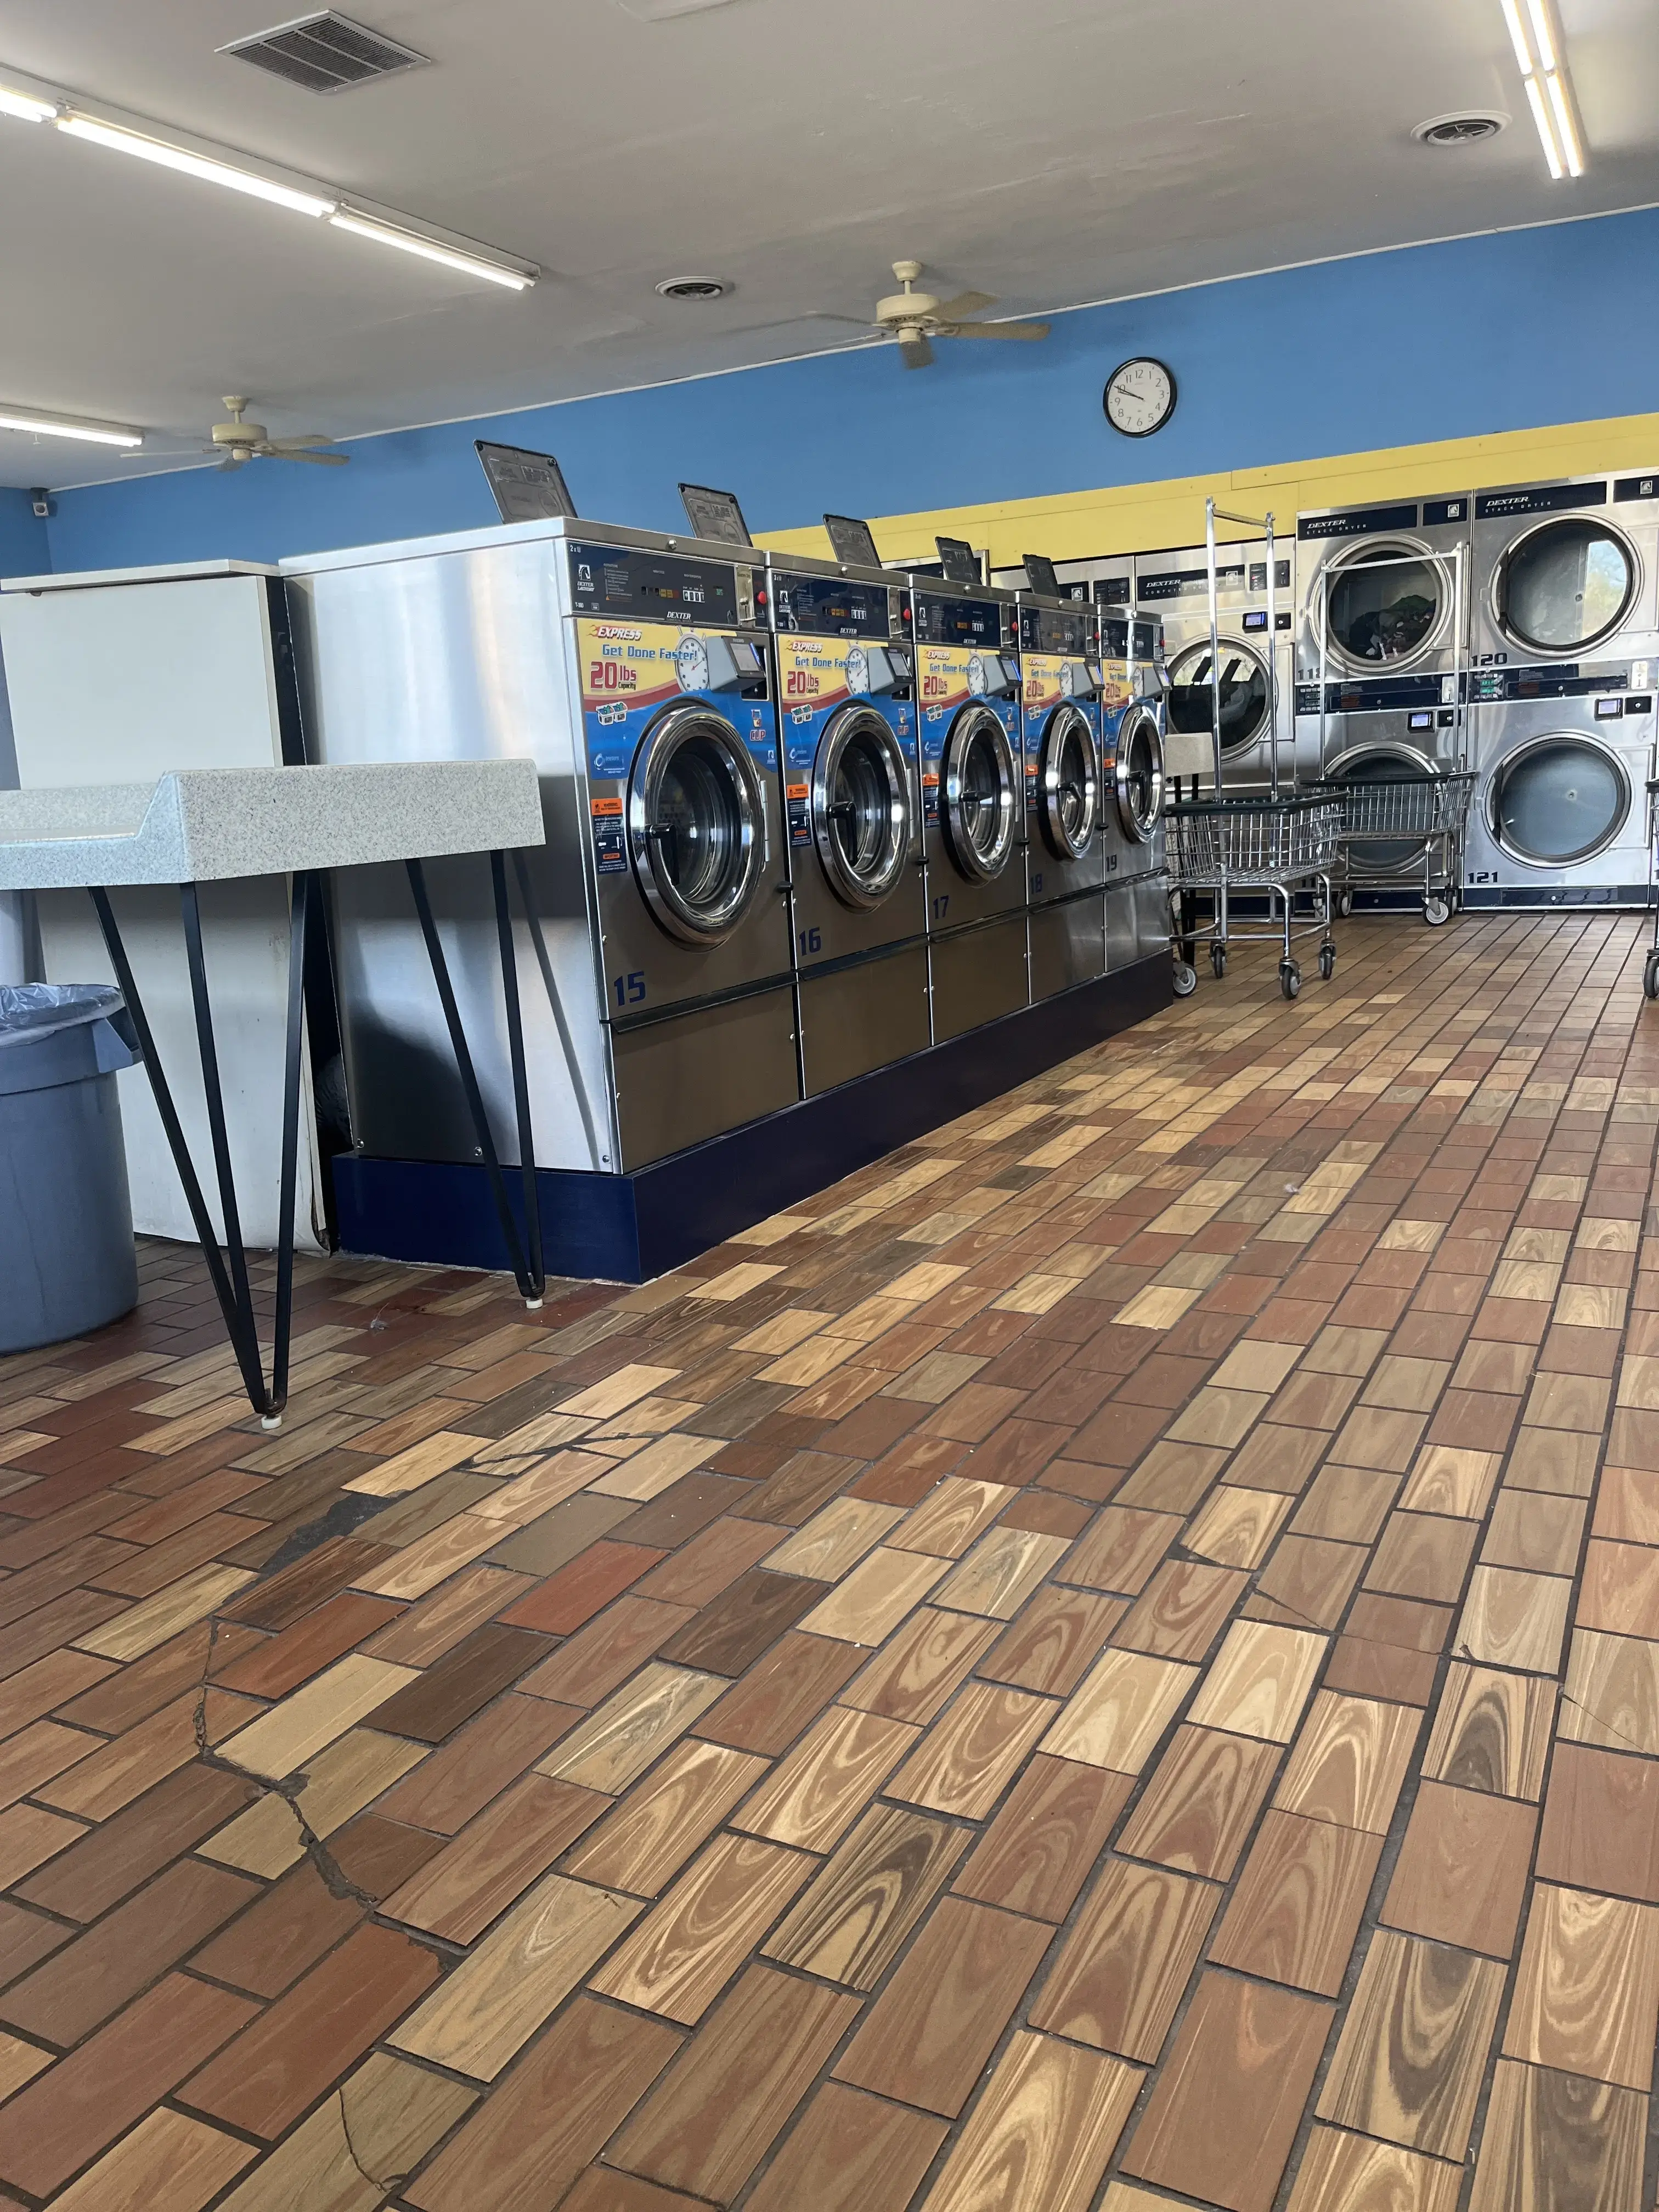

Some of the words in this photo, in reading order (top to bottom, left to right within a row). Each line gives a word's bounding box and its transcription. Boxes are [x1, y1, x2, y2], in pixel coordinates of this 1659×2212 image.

[1126, 375, 1131, 383] 11
[1136, 369, 1143, 379] 12
[1149, 371, 1152, 380] 1
[1155, 378, 1161, 387] 2
[1117, 384, 1125, 393] 10
[1159, 390, 1165, 399] 3
[1114, 397, 1120, 406] 9
[1155, 403, 1160, 411] 4
[1118, 409, 1124, 417] 8
[1148, 413, 1154, 422] 5
[1126, 416, 1131, 426] 7
[1137, 418, 1142, 426] 6
[1486, 496, 1529, 507] DEXTER
[1307, 520, 1346, 529] DEXTER
[1146, 579, 1181, 588] DEXTER
[667, 612, 691, 620] DEXTER
[597, 627, 642, 641] EXPRESS
[602, 644, 623, 657] Get
[627, 646, 656, 659] Done
[659, 648, 697, 661] Faster!
[792, 642, 823, 653] EXPRESS
[928, 651, 950, 660] EXPRESS
[1471, 653, 1507, 667] 120
[795, 657, 809, 666] Get
[812, 657, 832, 667] Done
[834, 658, 861, 668] Faster!
[943, 664, 957, 672] Done
[959, 664, 979, 673] Faster!
[590, 661, 618, 690] 20
[619, 665, 636, 681] lbs
[618, 681, 636, 691] Capacity
[787, 671, 806, 694] 20
[808, 674, 819, 687] lbs
[924, 675, 938, 695] 20
[938, 678, 947, 690] lbs
[1026, 680, 1037, 697] 20
[1106, 683, 1114, 698] 20
[750, 730, 766, 741] CUP
[1106, 854, 1117, 872] 19
[1468, 872, 1498, 884] 121
[1030, 873, 1042, 894] 18
[933, 895, 949, 919] 17
[799, 927, 821, 956] 16
[613, 970, 646, 1007] 15
